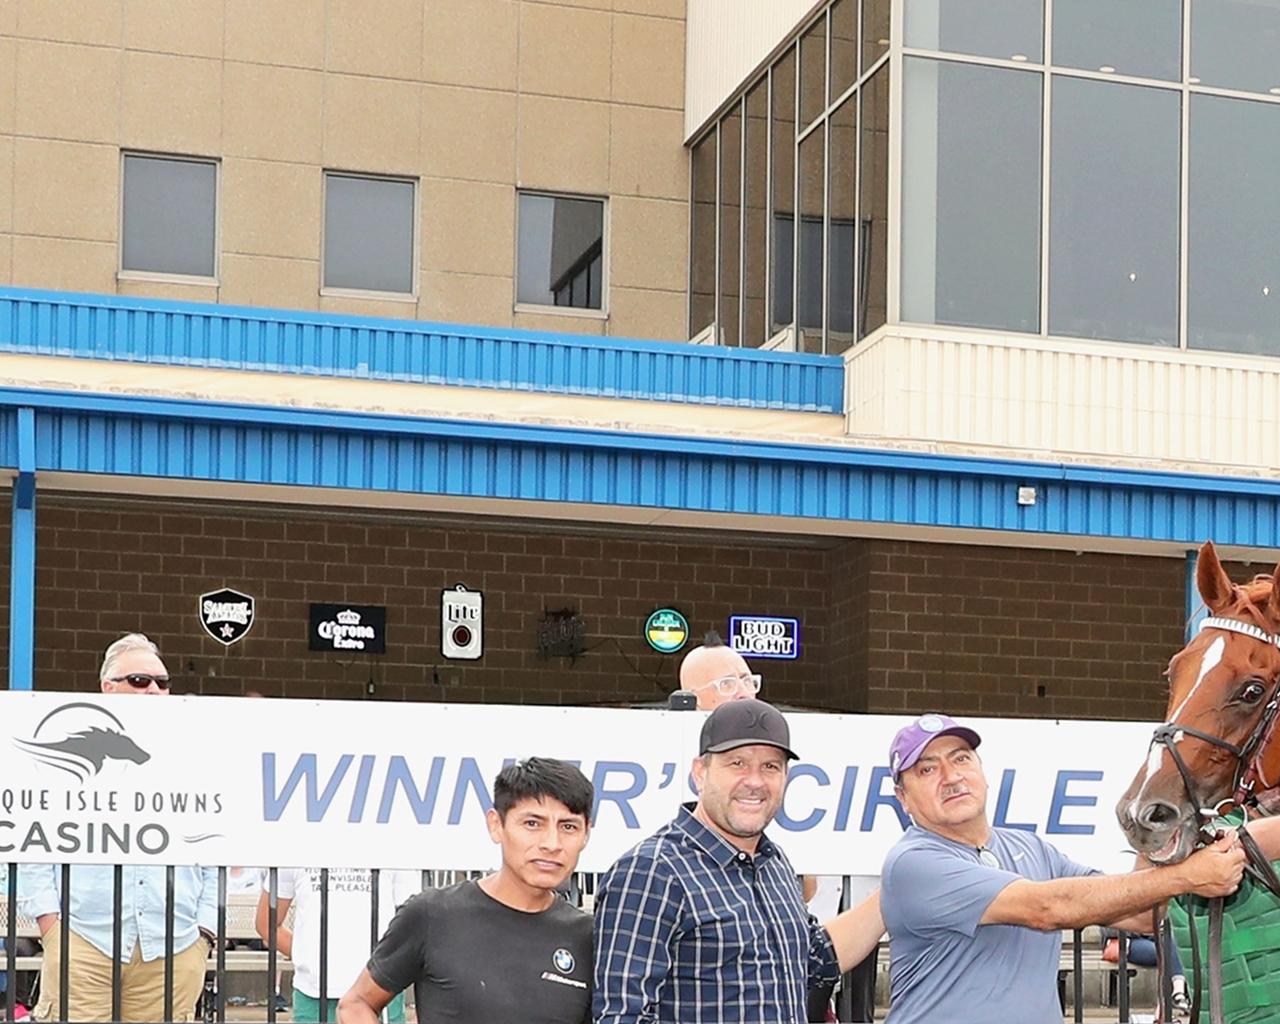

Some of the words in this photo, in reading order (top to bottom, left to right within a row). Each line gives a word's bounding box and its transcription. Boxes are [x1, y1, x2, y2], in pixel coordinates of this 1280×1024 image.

[318, 621, 375, 639] Corona
[741, 620, 785, 637] BUD
[733, 635, 794, 654] LIGHT
[66, 790, 118, 811] ISLE
[135, 792, 222, 814] DOWNS
[773, 763, 1104, 835] CIRLE
